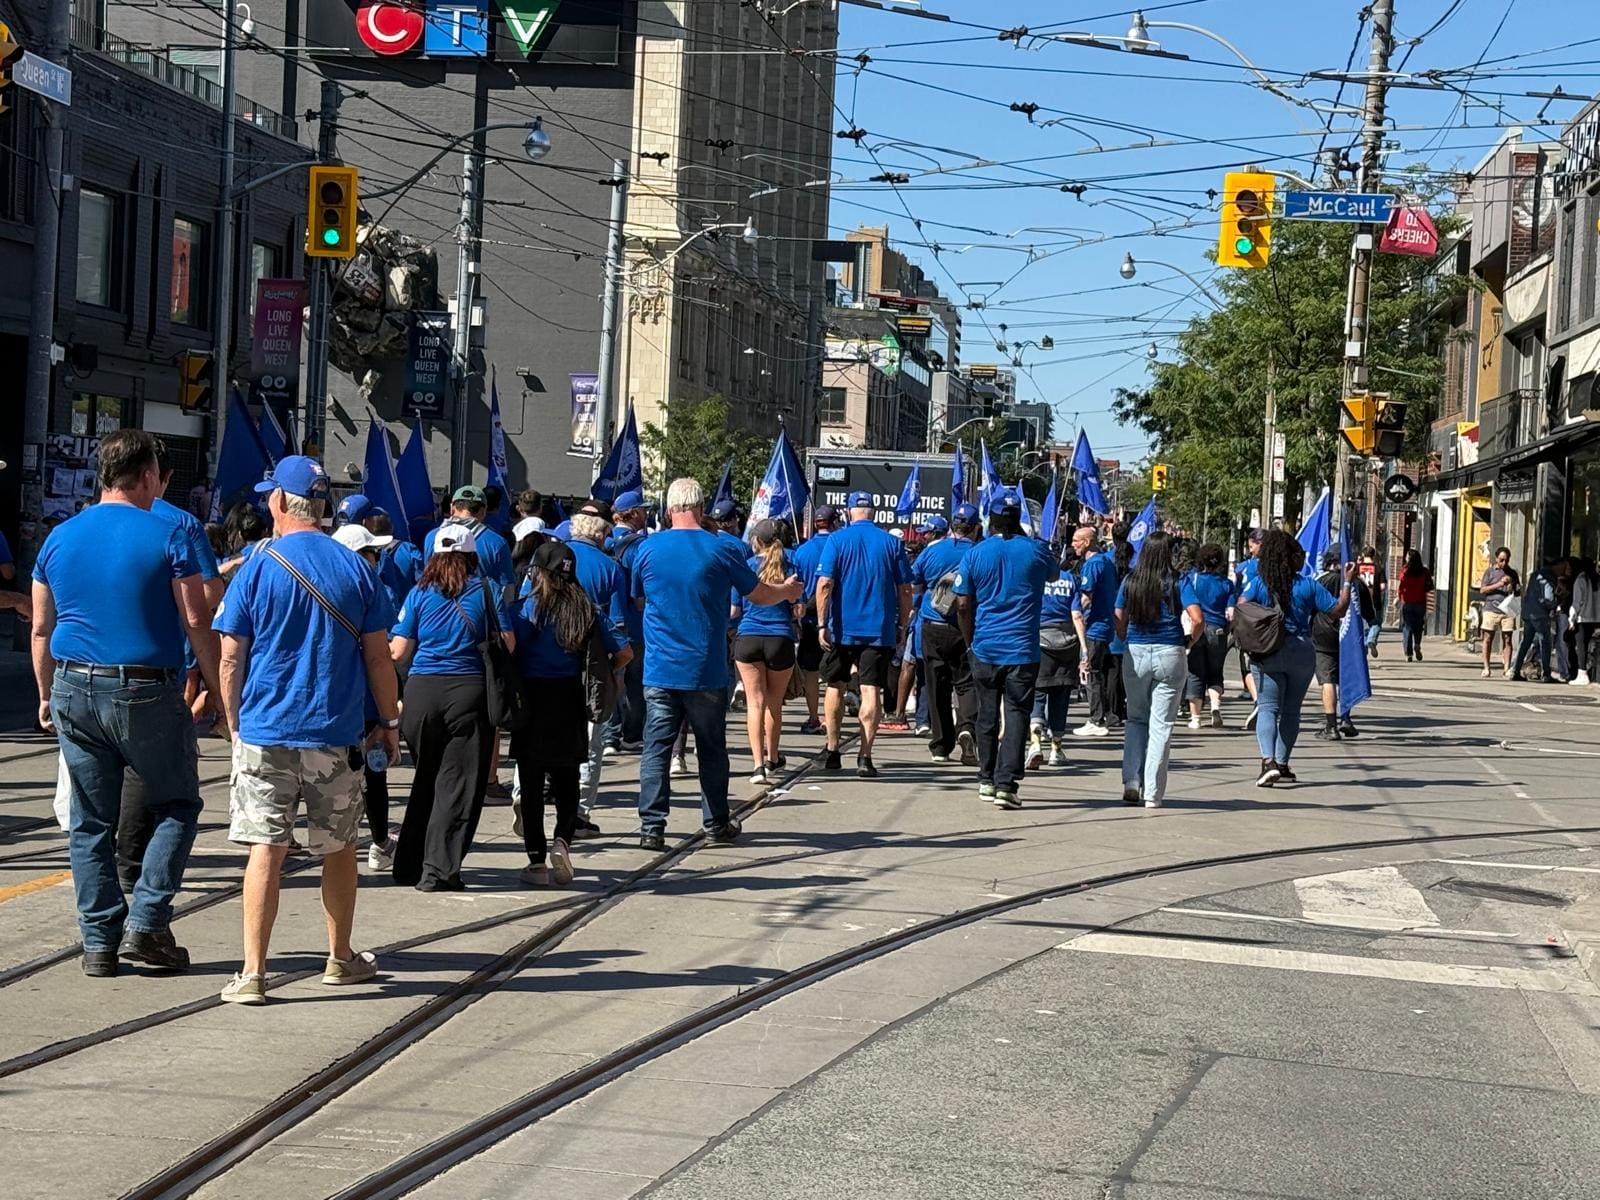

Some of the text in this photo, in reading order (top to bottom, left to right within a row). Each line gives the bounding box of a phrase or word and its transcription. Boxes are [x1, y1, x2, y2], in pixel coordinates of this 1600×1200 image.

[367, 3, 549, 46] CTV
[22, 56, 49, 88] Queen
[1308, 196, 1376, 217] McCaul
[1406, 213, 1418, 227] TO
[1390, 228, 1430, 245] CHEERS
[267, 309, 292, 321] LONG
[268, 325, 289, 337] LIVE
[262, 338, 292, 352] QUEEN
[419, 336, 440, 347] LONG
[264, 353, 288, 365] WEST
[420, 348, 437, 360] LIVE
[414, 360, 440, 372] QUEEN
[416, 373, 437, 384] WEST
[825, 491, 847, 506] THE
[883, 494, 898, 508] TO
[916, 496, 945, 510] TICE
[873, 510, 895, 524] JOB
[1053, 586, 1071, 598] ALL
